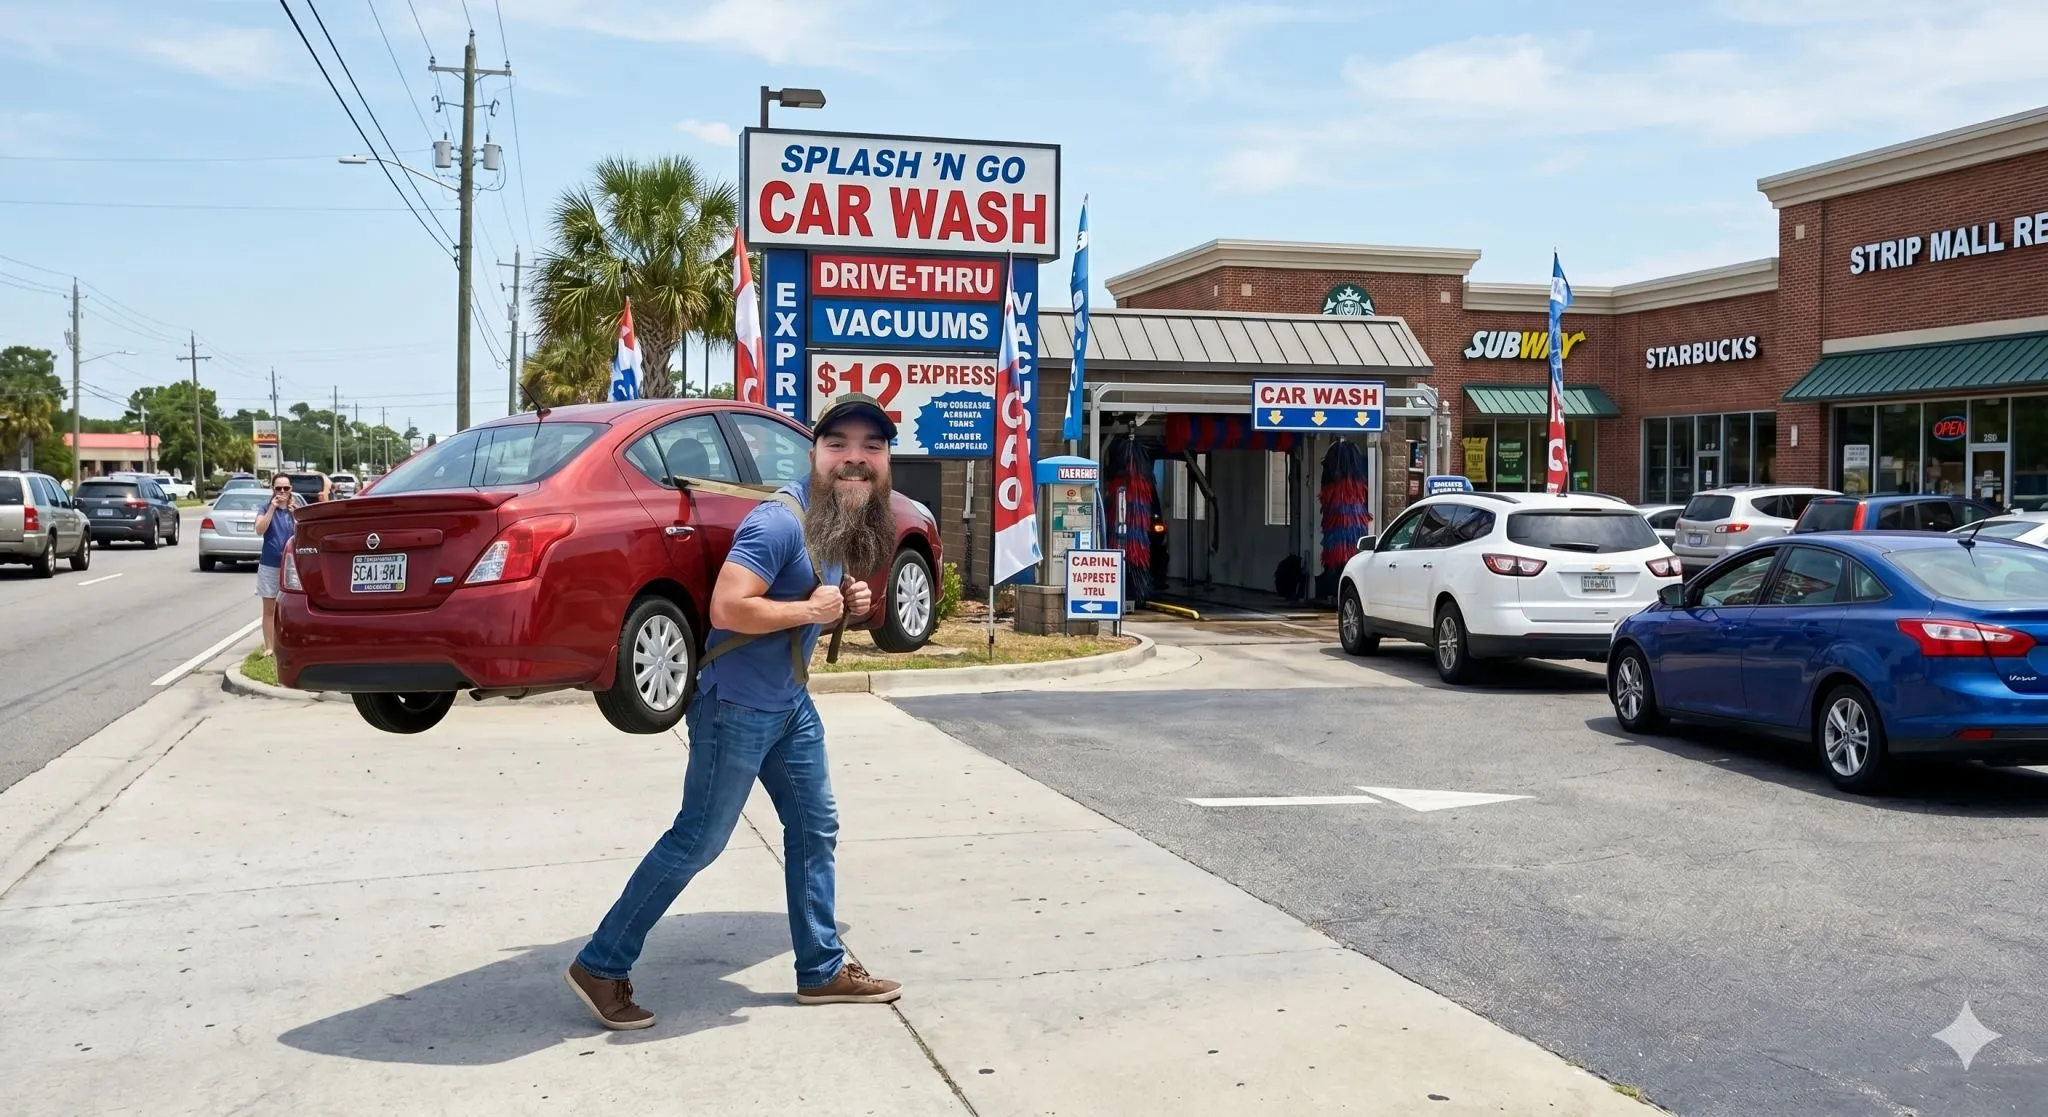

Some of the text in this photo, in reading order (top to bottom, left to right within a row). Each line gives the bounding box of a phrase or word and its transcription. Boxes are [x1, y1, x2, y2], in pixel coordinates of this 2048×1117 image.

[781, 144, 922, 178] SPLASH
[976, 155, 1025, 184] GO
[759, 180, 1046, 244] CAR WASH
[1850, 236, 1922, 275] STRIP
[1930, 222, 2005, 263] MALL
[820, 261, 994, 294] DRIVE-THRU
[826, 308, 989, 341] VACUUMS
[1646, 335, 1757, 369] STARBUCKS
[907, 364, 995, 386] EXPRESS
[1260, 386, 1377, 406] CAR WASH
[1934, 420, 1967, 436] OPEN
